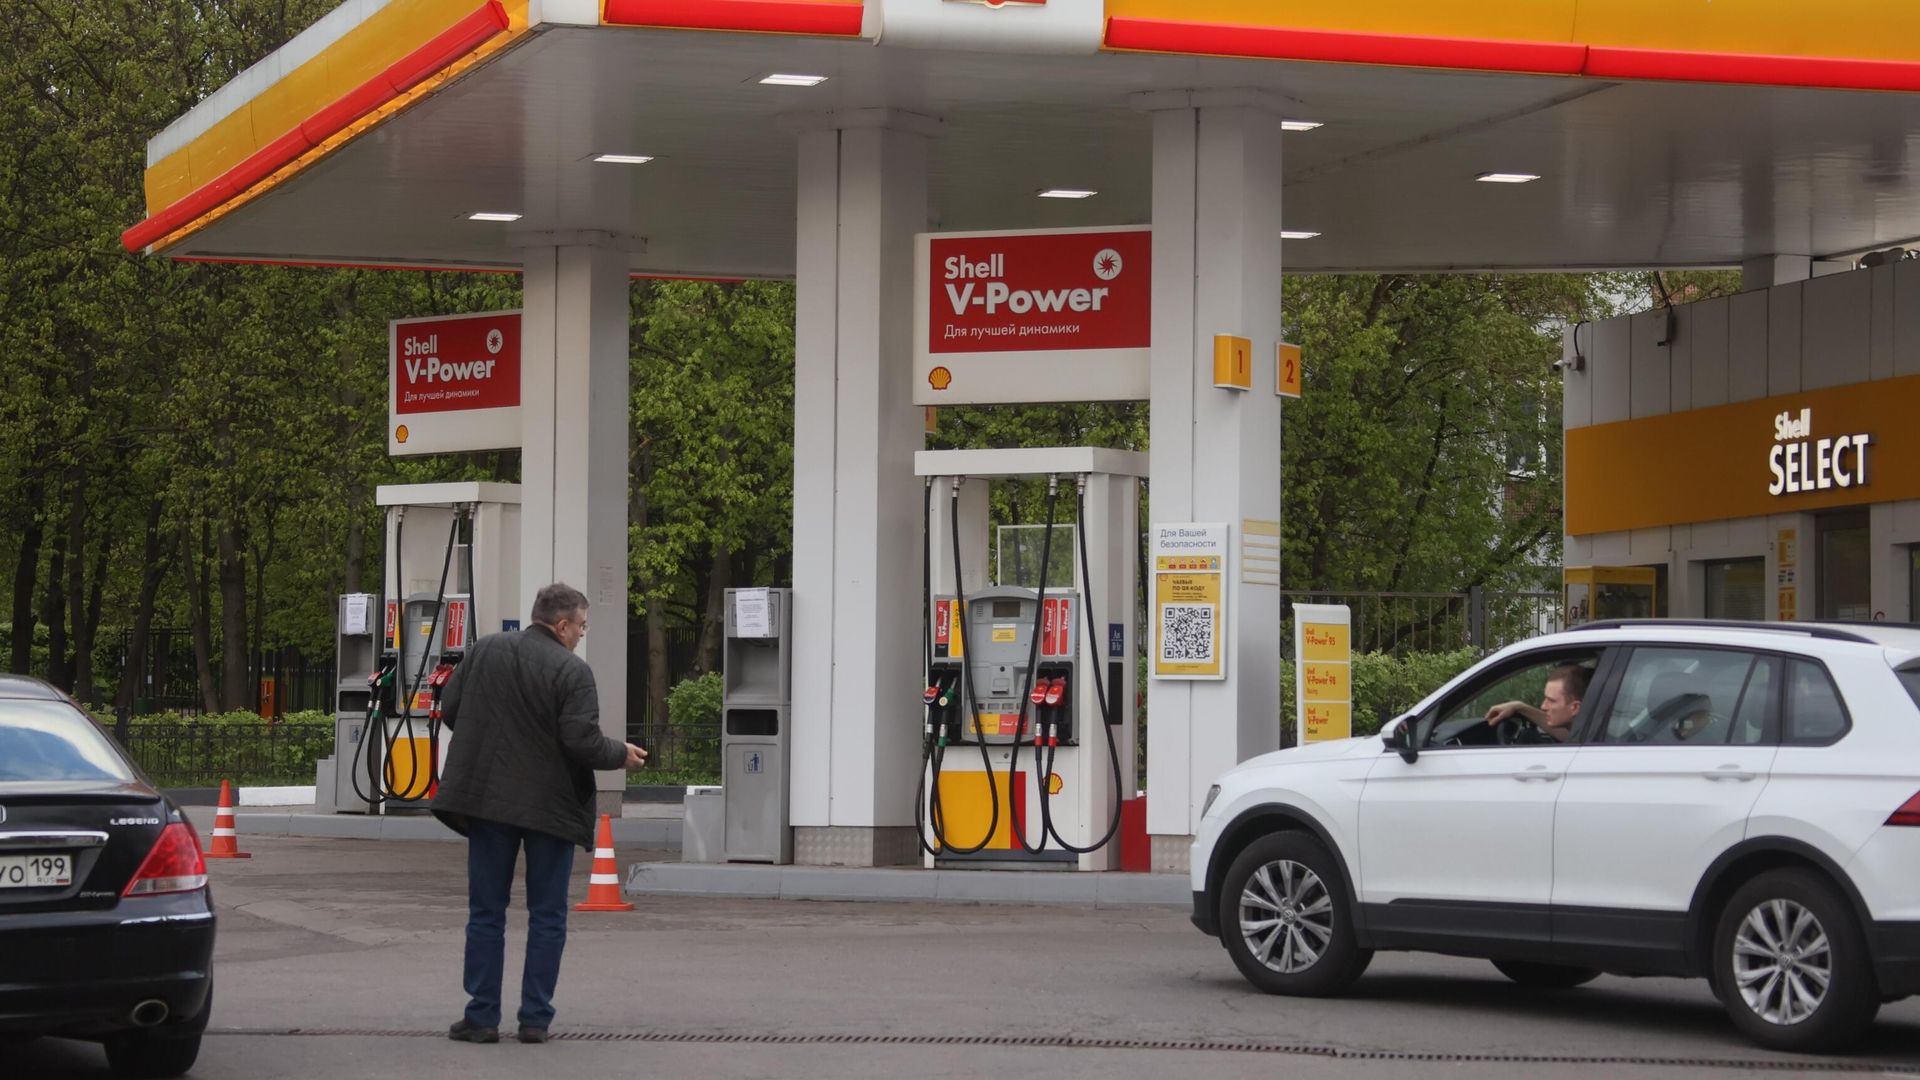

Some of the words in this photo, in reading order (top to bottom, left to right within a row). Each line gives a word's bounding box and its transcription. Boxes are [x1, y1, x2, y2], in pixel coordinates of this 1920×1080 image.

[944, 253, 1004, 279] Shell
[944, 282, 1108, 315] V-Power
[944, 324, 967, 339] Для
[970, 323, 1016, 340] лучшей
[1018, 324, 1080, 336] динамики
[404, 334, 437, 355] Shell
[404, 357, 496, 384] V-Power
[1238, 350, 1242, 373] 1
[1286, 359, 1294, 384] 2
[404, 391, 417, 403] Для
[418, 389, 444, 403] лучшей
[445, 389, 479, 399] динамики
[1774, 408, 1811, 441] Shell
[1768, 434, 1869, 495] SELECT
[1160, 529, 1177, 538] Для
[1178, 529, 1207, 537] Вашей
[1160, 540, 1216, 548] безопасности
[1306, 636, 1327, 645] V-Power
[110, 817, 159, 825] LEGEND
[30, 857, 65, 876] 199
